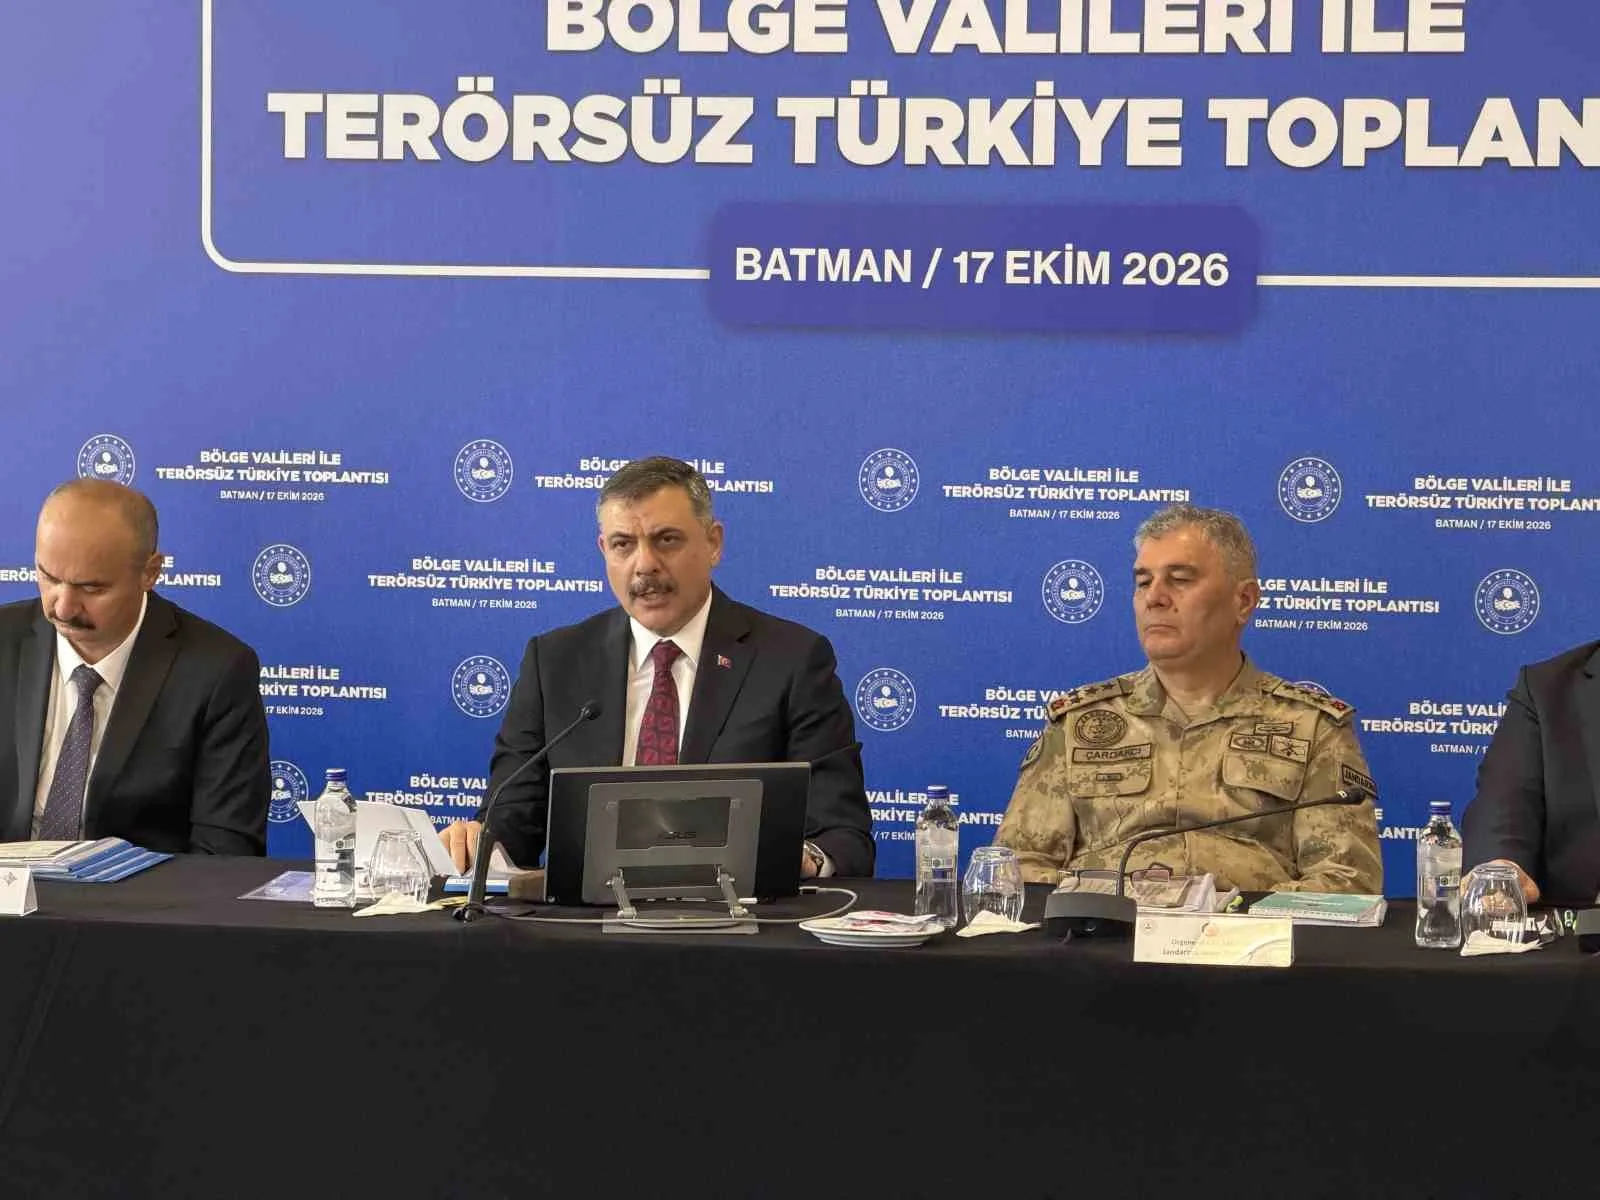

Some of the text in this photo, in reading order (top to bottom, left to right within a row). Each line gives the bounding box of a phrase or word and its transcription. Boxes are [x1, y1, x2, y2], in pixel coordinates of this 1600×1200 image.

[268, 77, 753, 163] TERÖRSÜZ
[777, 80, 1182, 165] TÜRKİYE
[736, 244, 1228, 288] BATMAN / 17 EKİM 2026
[201, 449, 341, 465] BÖLGE VALİLERİ İLE
[156, 465, 388, 483] TERÖRSÜZ TÜRKİYE TOPLANTISI
[702, 459, 724, 473] İLE
[990, 466, 1138, 482] BÖLGE VALİLERİ İLE
[535, 474, 773, 492] TERÖRSÜ PLANTISI
[1415, 475, 1570, 492] BÖLGE VALİLERİ İLE
[943, 483, 1189, 501] TERÖRSÜZ TÜRKİYE TOPLANTISI
[1366, 493, 1451, 508] TERÖRSÜZ
[1455, 495, 1524, 509] TÜRKİYE
[1010, 509, 1050, 518] BATMAN
[1059, 510, 1068, 518] 17
[1070, 509, 1094, 518] EKİM
[1436, 519, 1477, 528] BATMAN
[1499, 520, 1524, 528] EKİM
[413, 556, 554, 573] BÖLGE VALİLERİ İLE
[155, 574, 220, 586] PLANTISI
[368, 573, 603, 592] TERÖRSÜZ TÜRKİYE TOPLANTISI
[816, 566, 962, 583] BÖLGE VALİLERİ İLE
[770, 583, 1012, 602] TERÖRSÜZ TÜRKİYE TOPLANTISI
[1257, 578, 1387, 593] LGE VALİLERİ İLE
[432, 598, 470, 607] BATMAN
[1274, 595, 1341, 610] TÜRKİYE
[1345, 599, 1439, 612] TOPLANTISI
[836, 609, 875, 618] BATMAN
[884, 610, 893, 618] 17
[895, 609, 918, 619] EKİM
[1256, 619, 1296, 628] BATMAN
[1317, 620, 1341, 629] EKİM
[260, 665, 339, 680] ALİLERİ İLE
[259, 682, 386, 698] RKİYE TOPLANTISI
[986, 687, 1036, 701] BÖLGE
[939, 704, 1020, 719] TERÖRSÜZ
[1410, 700, 1507, 717] BÖLGE VALİ
[1361, 718, 1497, 735] TERÖRSÜZ TÜRKİ
[1431, 744, 1472, 753] BATMAN
[411, 774, 458, 788] BÖLGE
[365, 791, 443, 805] TERÖRSÜZ
[866, 790, 928, 804] VALİLER
[871, 807, 915, 822] RKİYE
